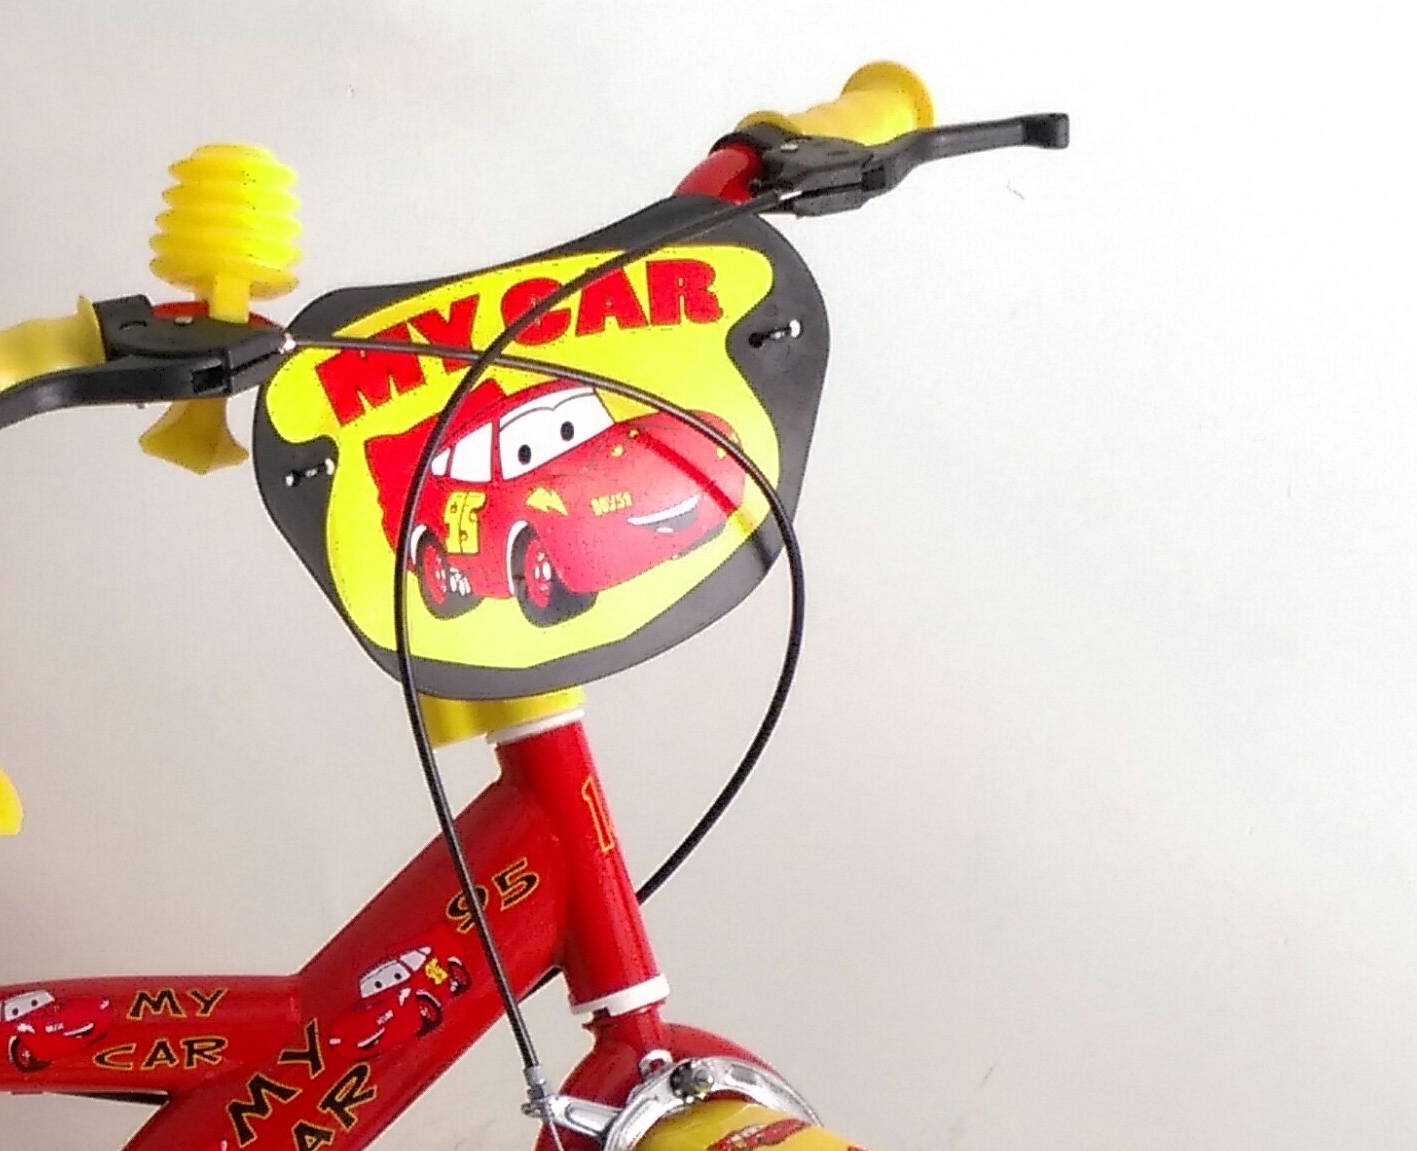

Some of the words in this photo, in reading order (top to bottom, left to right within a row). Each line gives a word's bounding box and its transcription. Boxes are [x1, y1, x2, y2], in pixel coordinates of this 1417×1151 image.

[315, 293, 480, 427] MY
[500, 258, 724, 347] CAR
[445, 857, 540, 934] 95
[126, 987, 229, 1020] MY
[92, 1036, 228, 1072] CAR
[226, 1017, 325, 1148] MY
